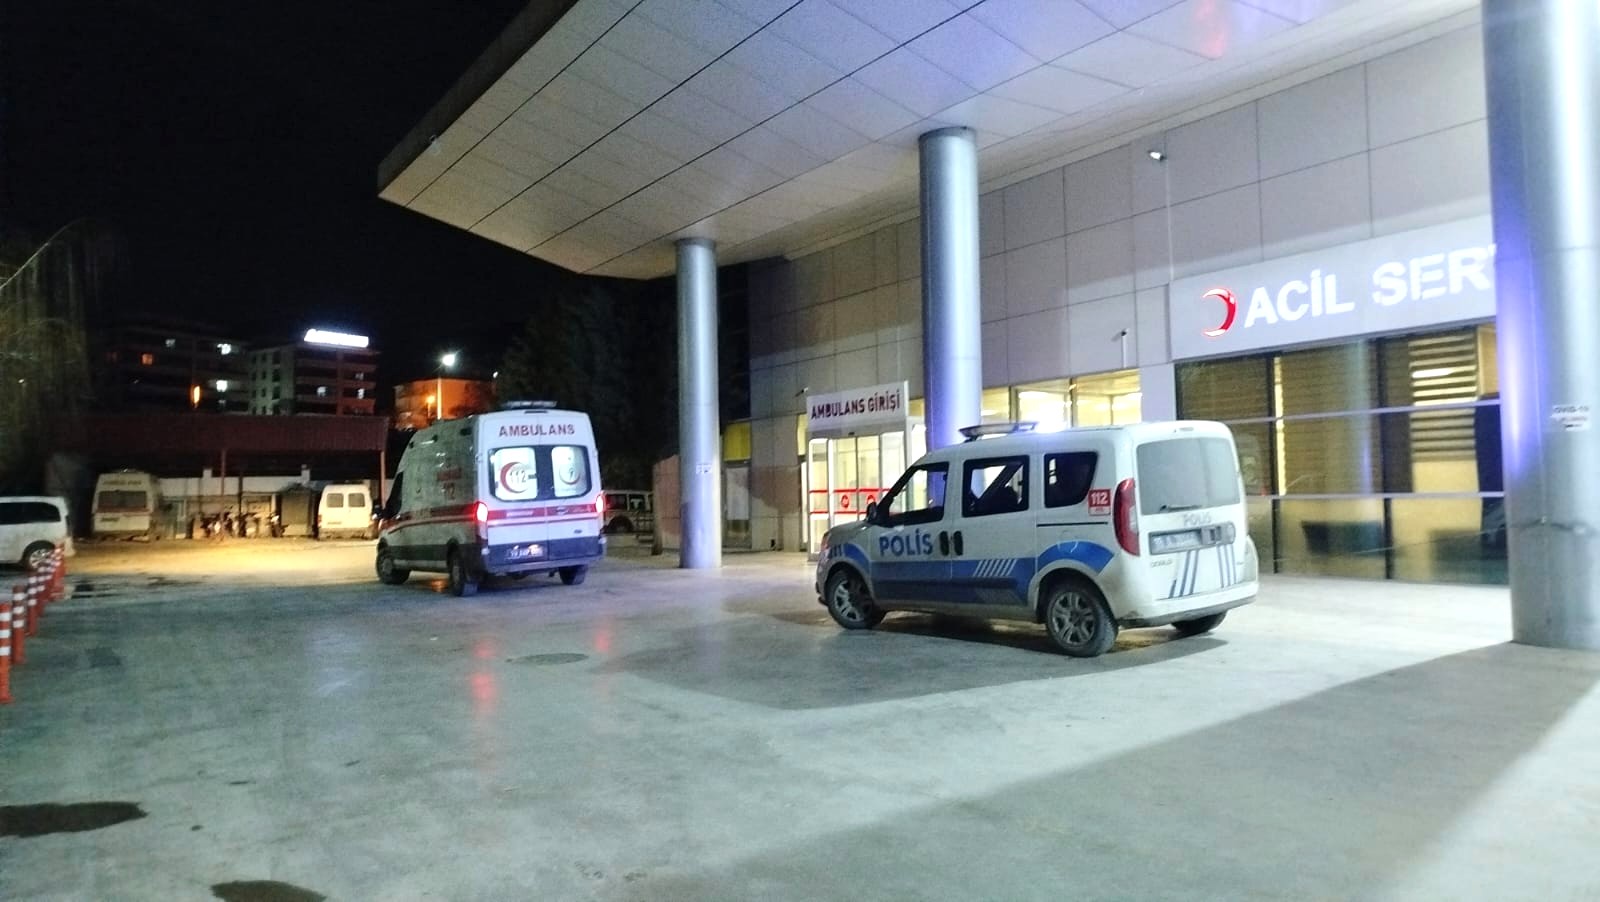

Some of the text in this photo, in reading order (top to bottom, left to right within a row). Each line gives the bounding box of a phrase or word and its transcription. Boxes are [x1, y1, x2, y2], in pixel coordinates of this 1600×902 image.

[1244, 244, 1496, 328] ACİL SER
[811, 388, 900, 419] AMBULANS GİRİŞİ
[499, 424, 575, 437] AMBULANS
[1091, 491, 1108, 505] 112
[879, 527, 933, 557] POLİS
